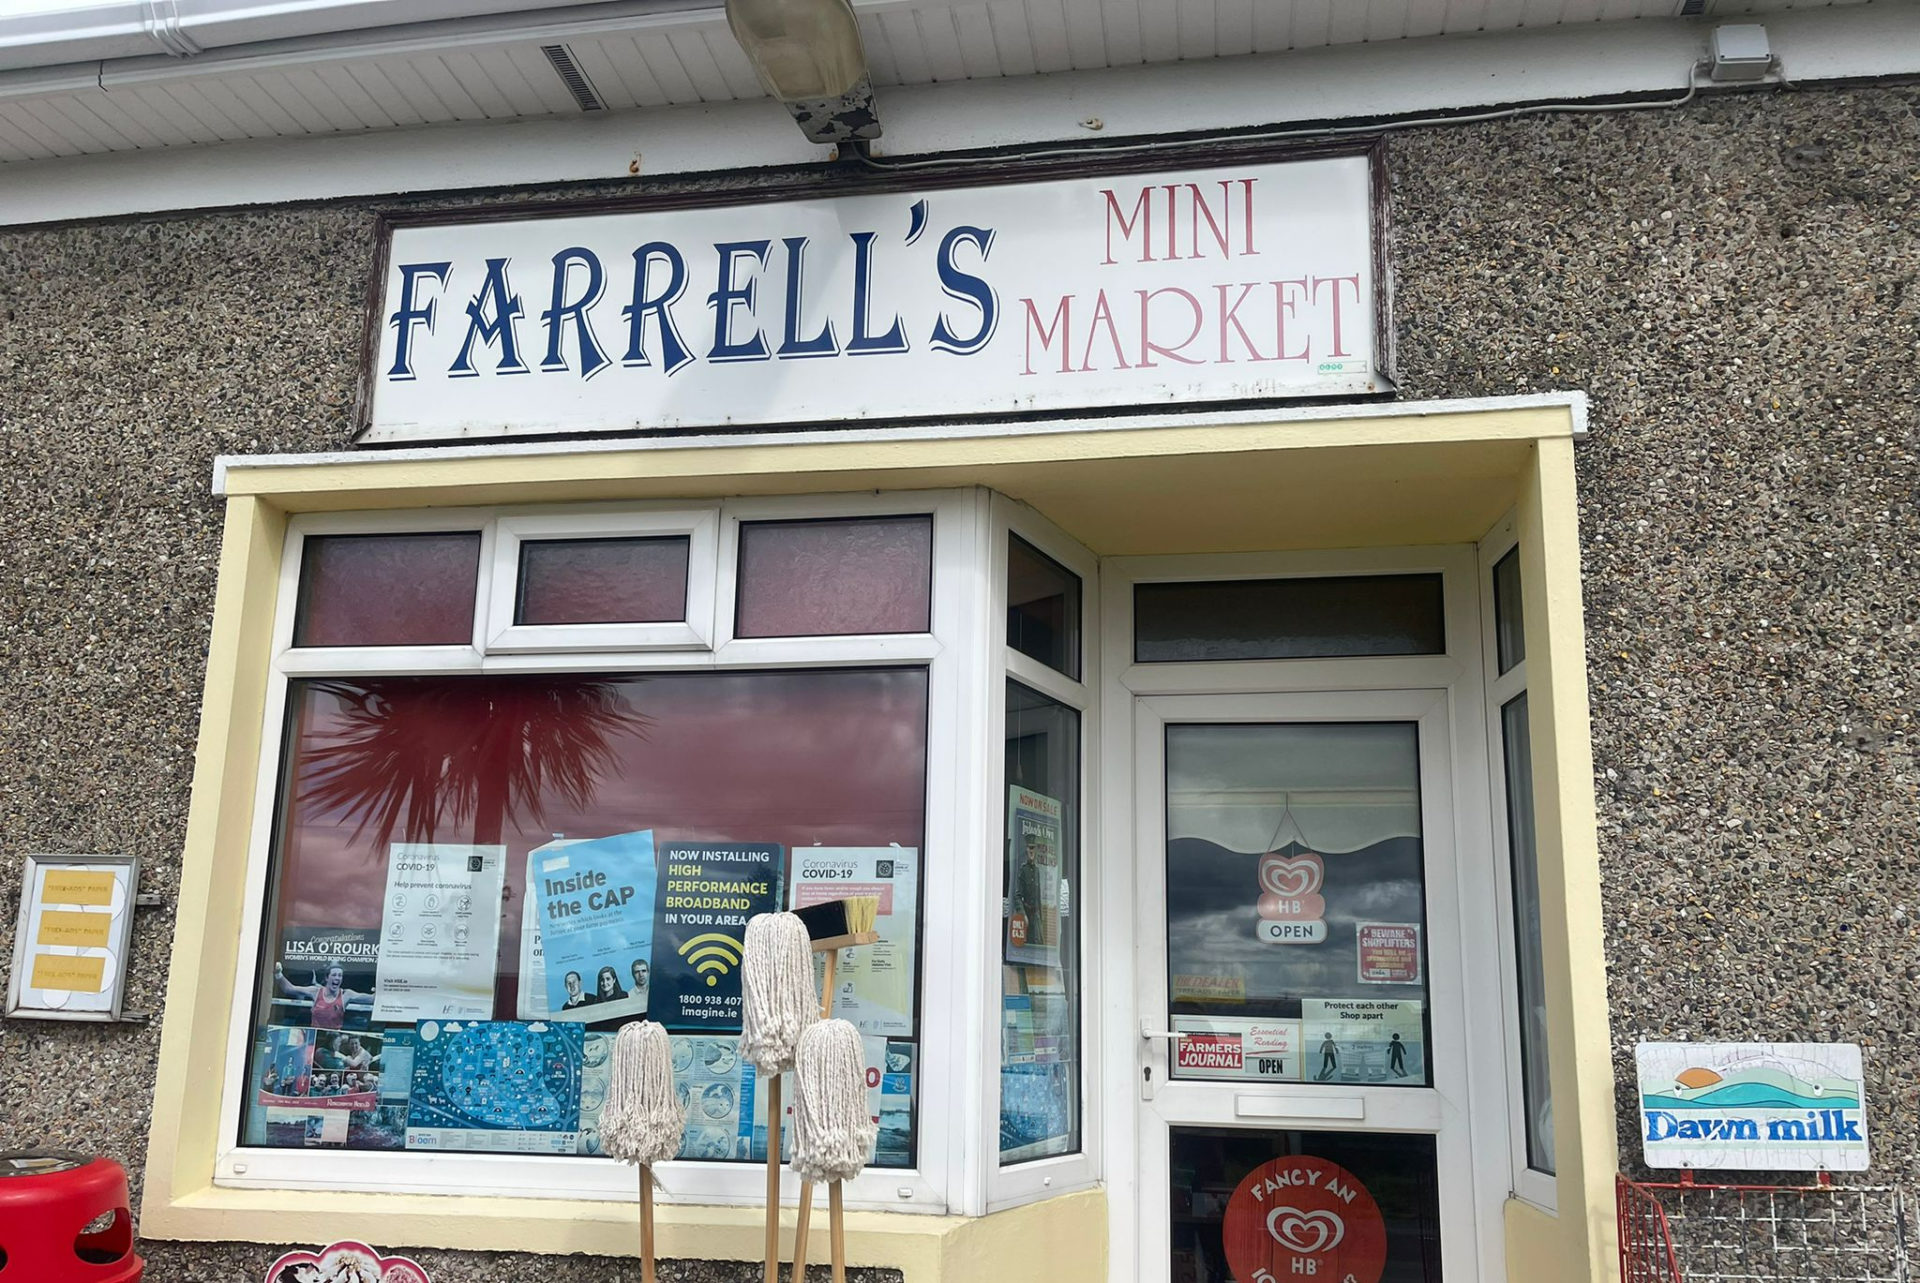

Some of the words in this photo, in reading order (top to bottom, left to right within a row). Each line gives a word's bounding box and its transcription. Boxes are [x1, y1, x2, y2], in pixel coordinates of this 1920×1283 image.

[1100, 178, 1260, 265] MINI
[387, 199, 999, 382] FARRELL'S
[1019, 273, 1360, 376] MARKET
[397, 852, 440, 861] Coronavirus
[670, 850, 700, 860] NOW
[702, 851, 770, 862] INSTALLING
[396, 863, 435, 871] COVID-19
[668, 864, 702, 876] HIGH
[802, 859, 858, 869] Coronavirus
[802, 869, 853, 879] COVID-19
[394, 881, 409, 889] Help
[435, 882, 472, 890] coronavirus
[545, 870, 606, 896] Inside
[667, 880, 768, 894] PERFORMANCE
[547, 900, 581, 919] the
[588, 886, 635, 911] CAP
[666, 896, 751, 910] BROADBAND
[1279, 900, 1301, 914] HB
[665, 913, 678, 924] IN
[680, 914, 712, 925] YOUR
[715, 915, 747, 926] AREA
[1270, 925, 1313, 937] OPEN
[1371, 928, 1406, 938] BEWARE
[286, 941, 314, 952] LISA
[318, 942, 380, 955] O'ROURK
[1362, 937, 1416, 949] SHOPLIFTERS
[679, 994, 702, 1004] 1800
[704, 996, 722, 1005] 938
[724, 996, 742, 1006] 407
[1324, 1001, 1354, 1009] Protect
[1356, 1002, 1375, 1010] each
[1376, 1002, 1398, 1010] other
[682, 1006, 737, 1019] imagine.ie
[1340, 1011, 1360, 1020] Shop
[1362, 1012, 1383, 1020] apart
[1250, 1026, 1288, 1036] Essential
[1180, 1042, 1241, 1053] FARMERS
[1254, 1037, 1288, 1049] Reading
[1180, 1053, 1241, 1067] JOURNAL
[1259, 1059, 1283, 1074] OPEN
[1646, 1110, 1760, 1141] Dawn
[1768, 1109, 1863, 1141] milk
[1250, 1168, 1322, 1202] FANCY
[1324, 1177, 1357, 1204] AN
[1291, 1257, 1316, 1275] HB
